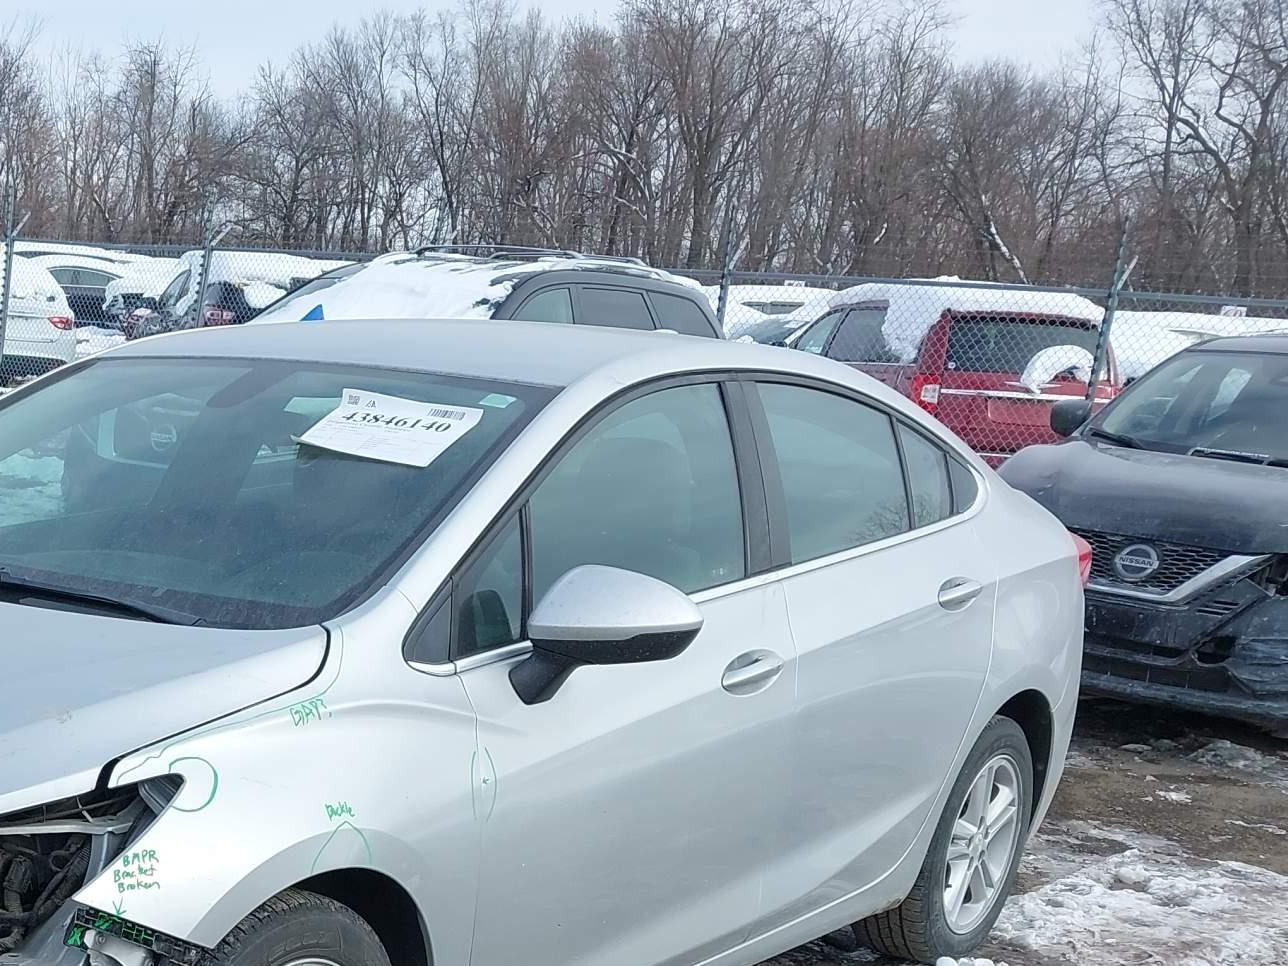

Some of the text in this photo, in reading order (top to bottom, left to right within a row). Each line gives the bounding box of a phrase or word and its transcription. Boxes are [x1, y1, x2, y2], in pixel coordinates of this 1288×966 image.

[342, 411, 453, 434] 43846140
[1119, 556, 1154, 567] NISSAN
[122, 849, 160, 868] BMPR
[113, 863, 159, 883] Bracket
[117, 879, 161, 894] Broken
